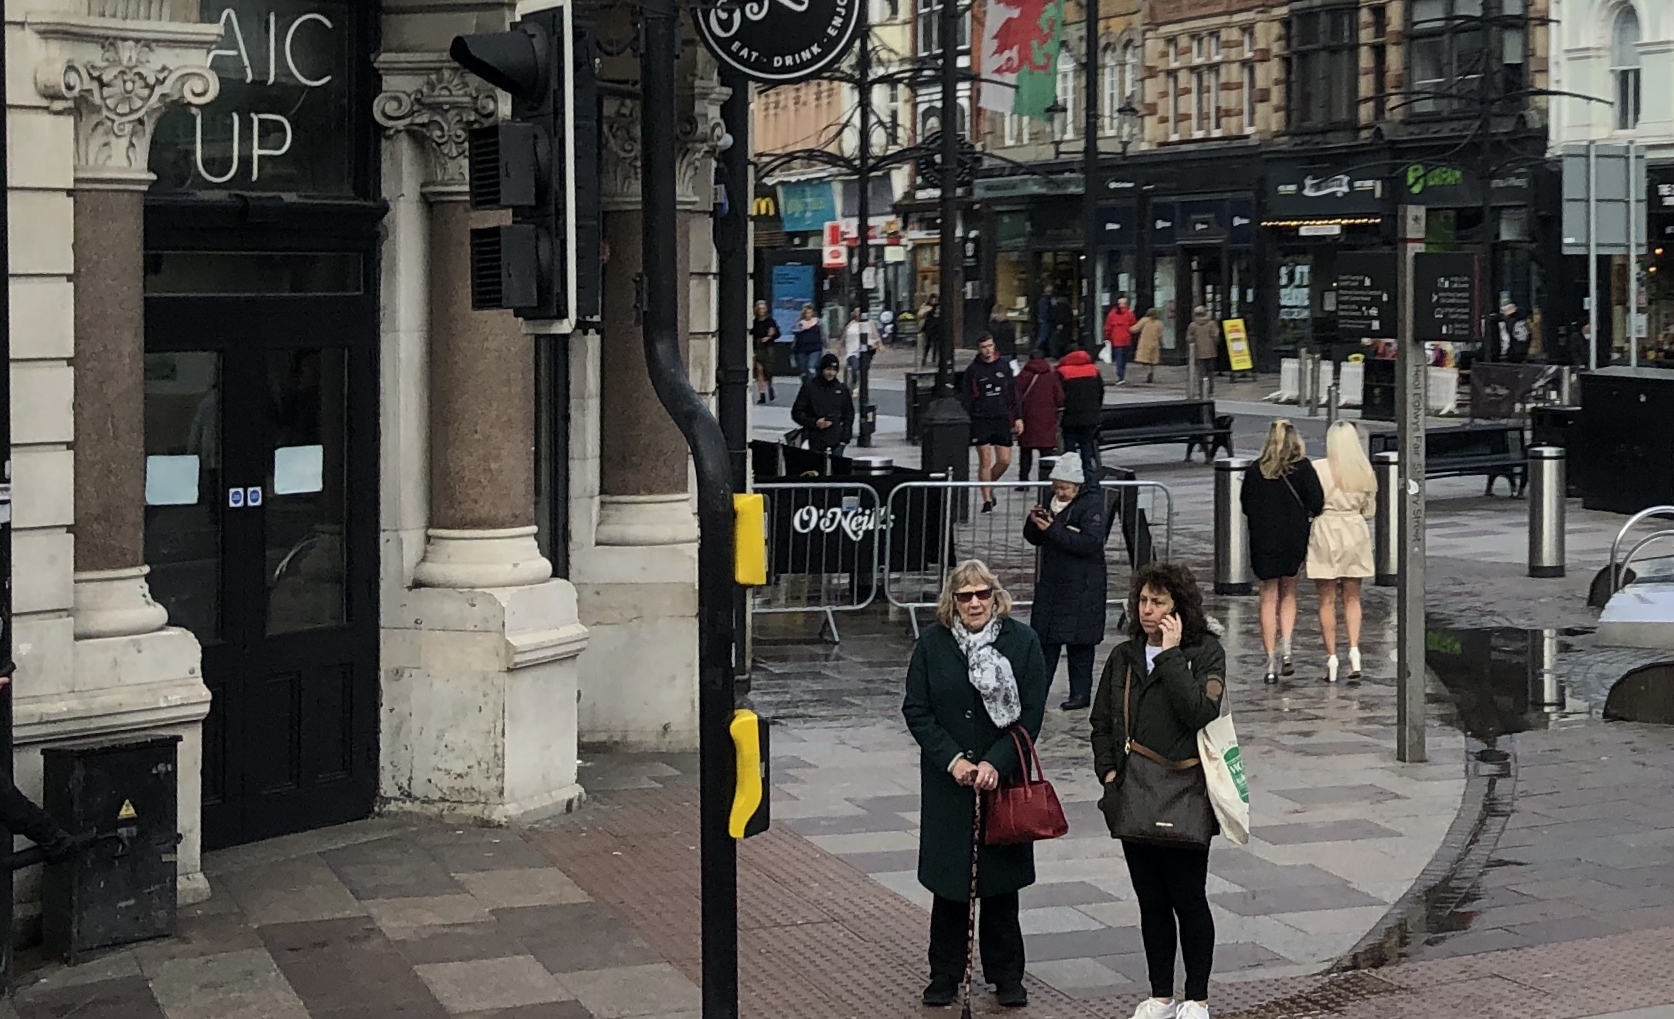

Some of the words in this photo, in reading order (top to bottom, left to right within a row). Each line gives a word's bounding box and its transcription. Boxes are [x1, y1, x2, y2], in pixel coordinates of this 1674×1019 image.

[731, 40, 760, 62] EAT
[773, 42, 822, 67] DRINK
[195, 111, 292, 183] UP
[1412, 435, 1422, 456] Fair
